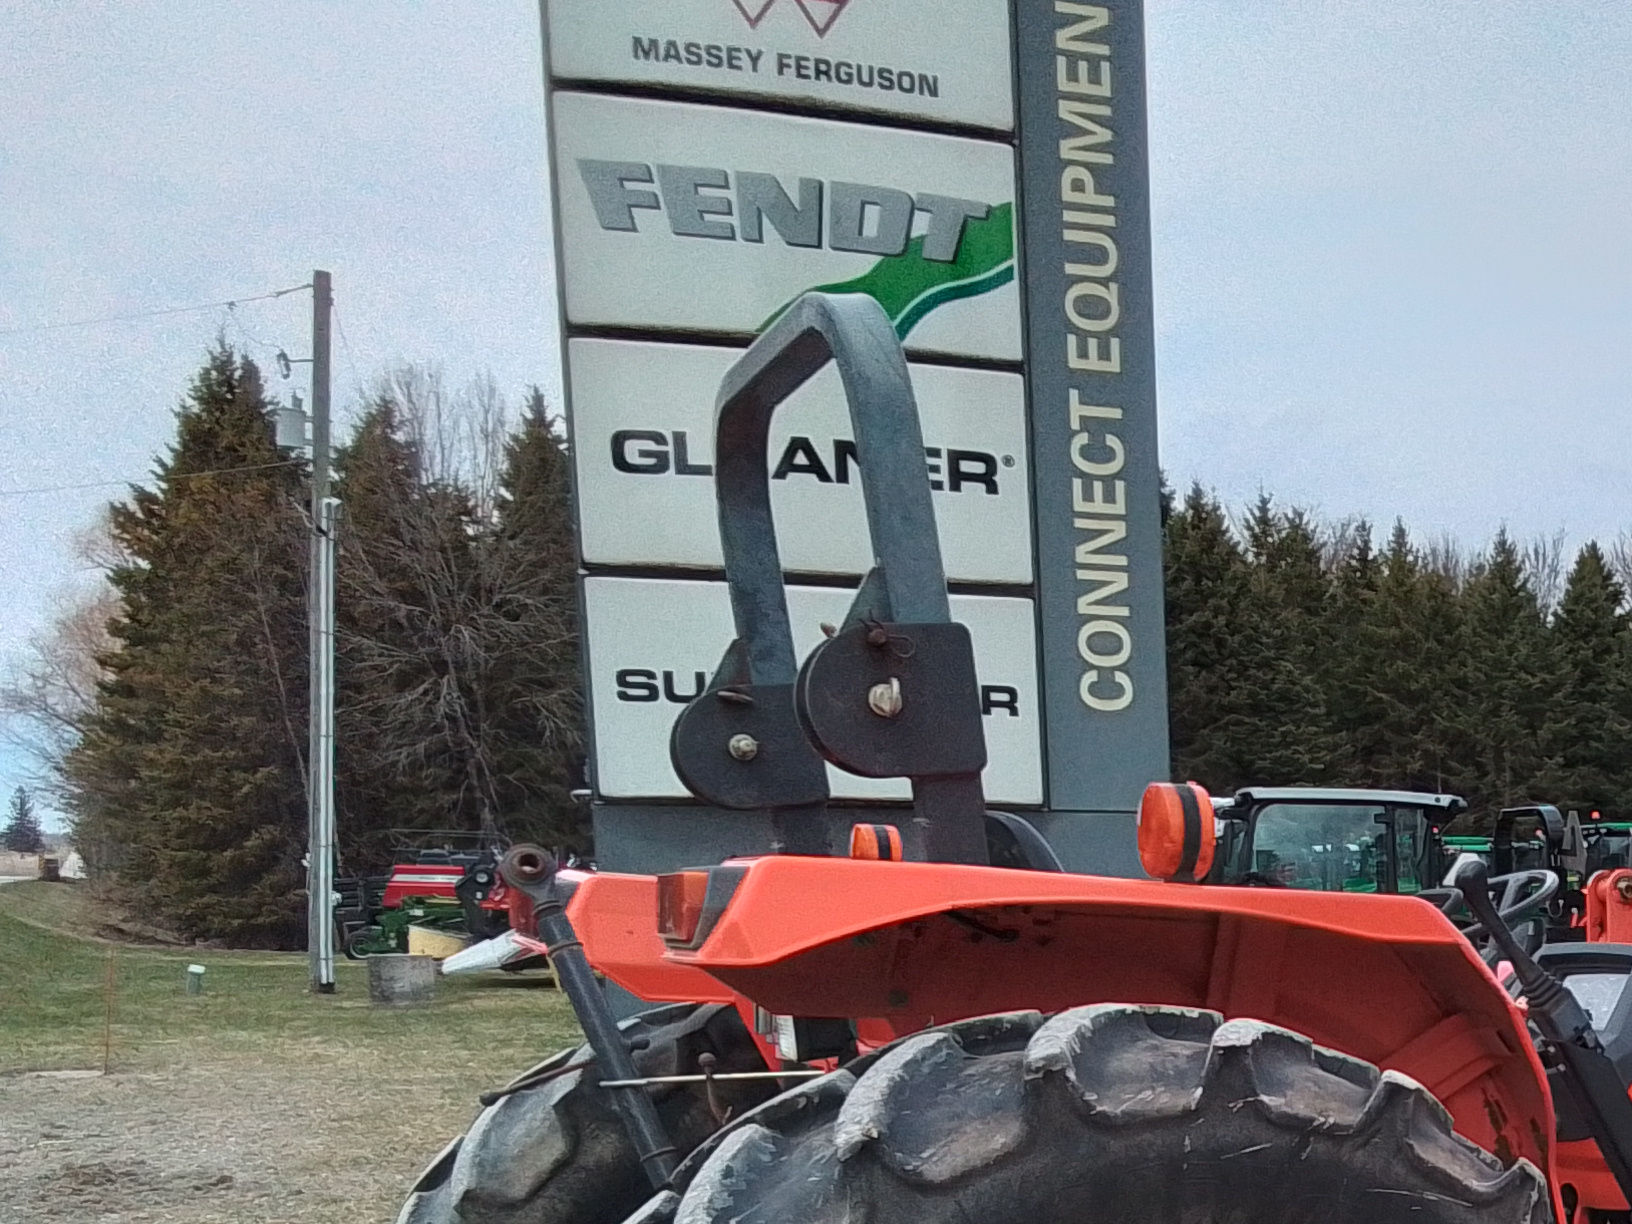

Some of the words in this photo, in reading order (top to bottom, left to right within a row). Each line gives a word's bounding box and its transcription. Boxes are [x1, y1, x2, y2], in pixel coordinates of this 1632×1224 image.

[631, 35, 764, 74] MASSEY
[776, 52, 941, 99] FERGUSON
[577, 158, 991, 266] FENDT
[1054, 0, 1121, 374] EQUIPMEN
[1068, 387, 1134, 712] CONNECT
